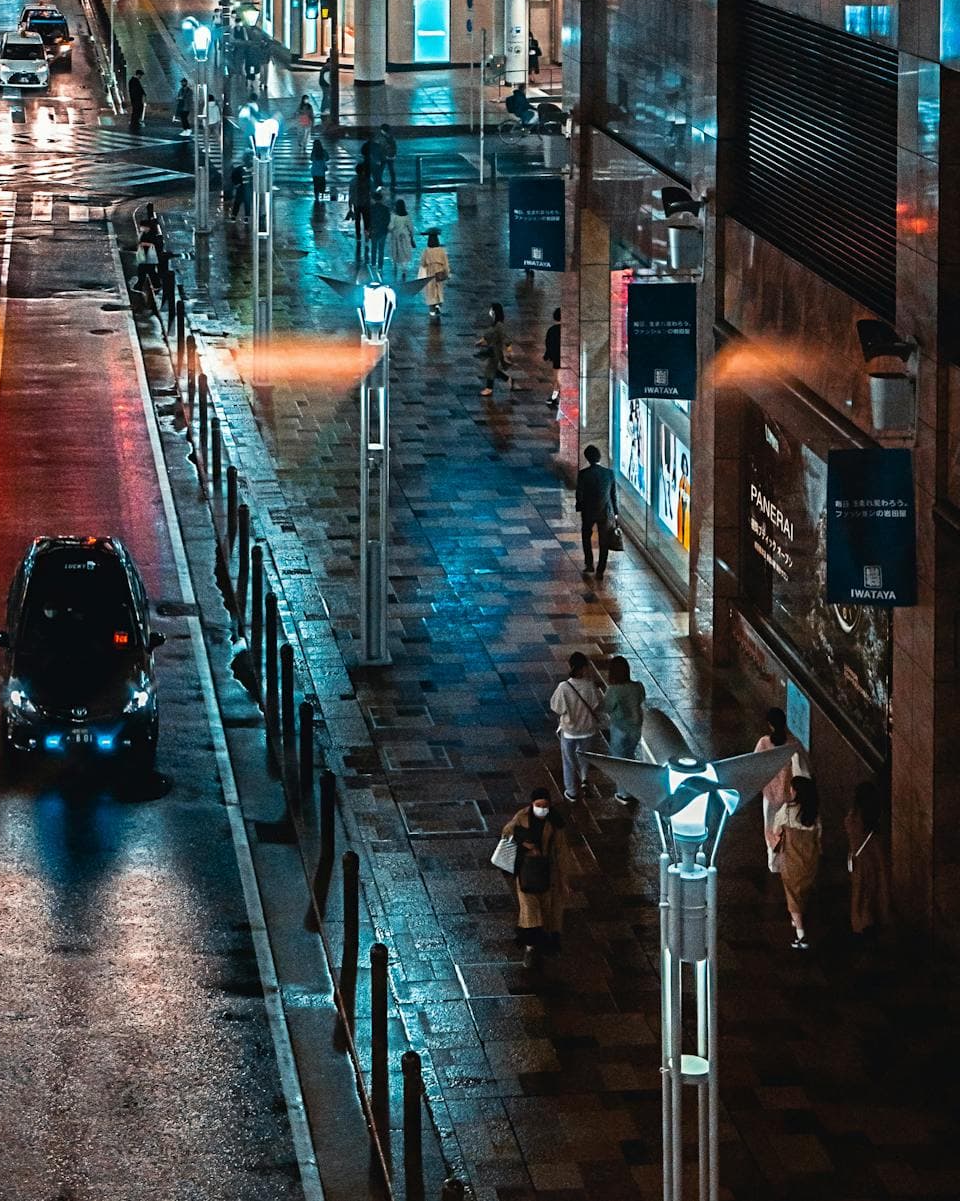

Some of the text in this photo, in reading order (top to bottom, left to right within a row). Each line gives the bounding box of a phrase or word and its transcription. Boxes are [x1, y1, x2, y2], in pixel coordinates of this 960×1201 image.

[644, 387, 679, 395] IWATAYA
[750, 483, 794, 542] PANERAI
[850, 588, 897, 600] IWATAYA
